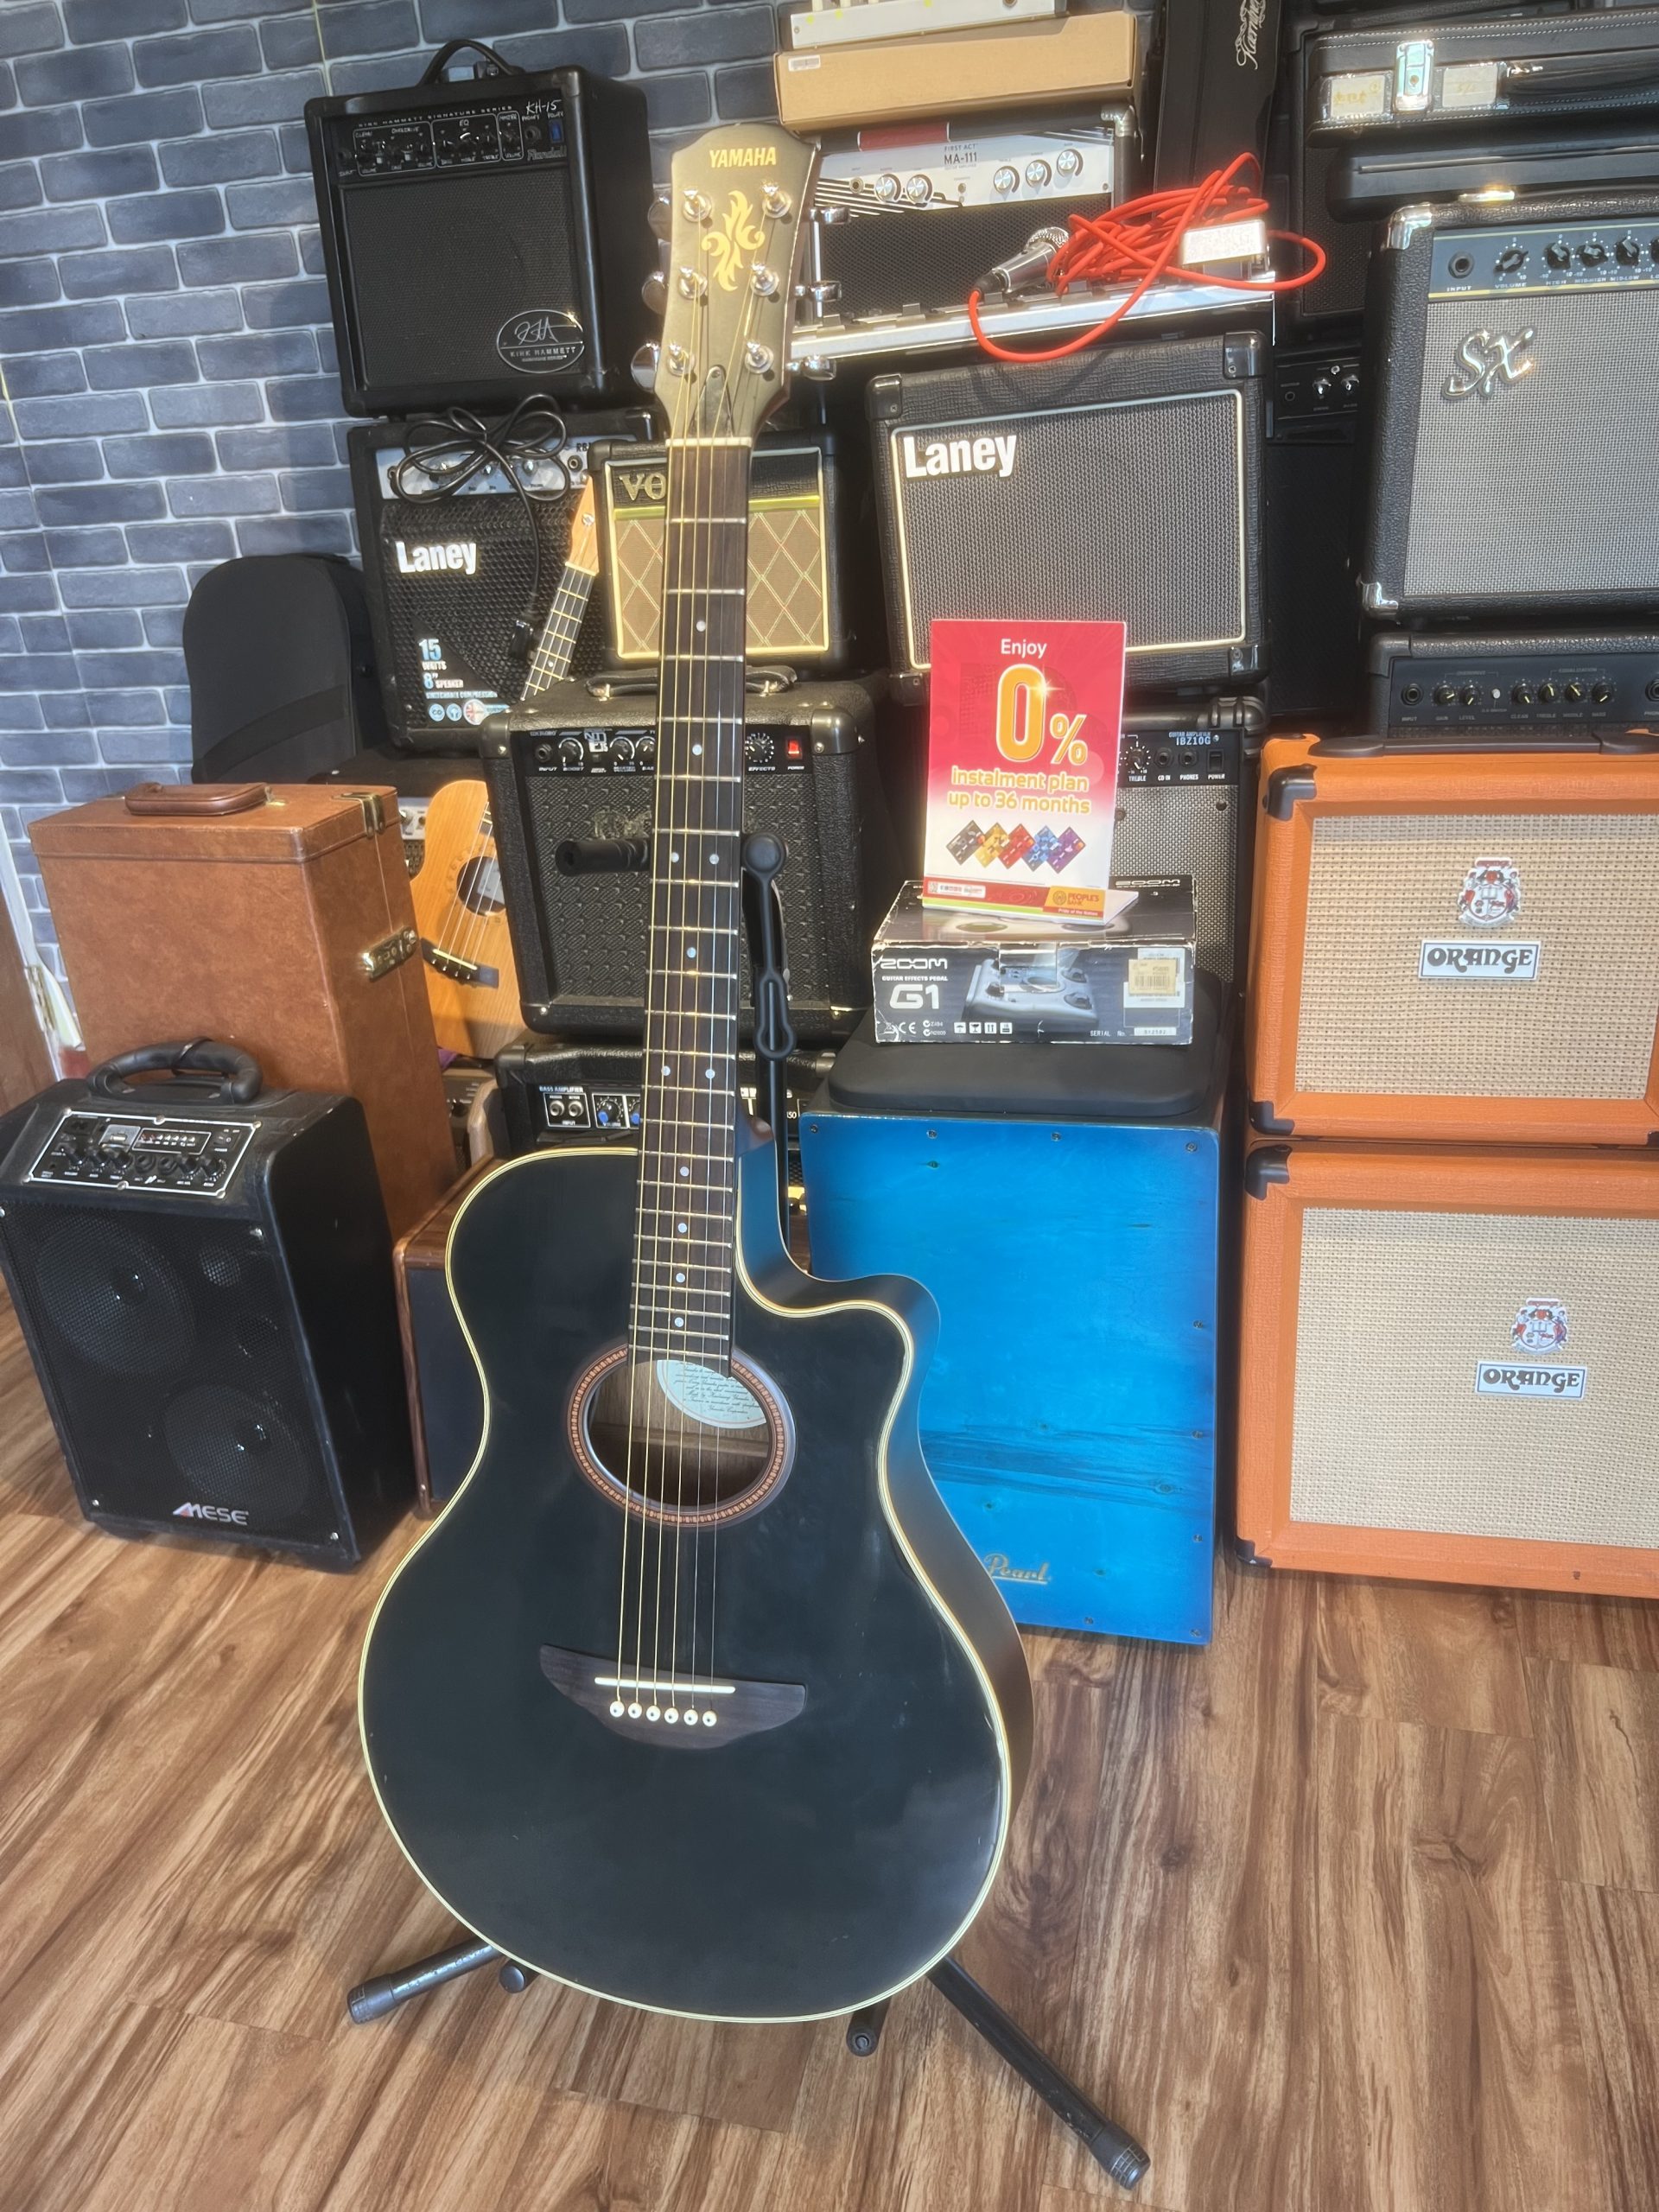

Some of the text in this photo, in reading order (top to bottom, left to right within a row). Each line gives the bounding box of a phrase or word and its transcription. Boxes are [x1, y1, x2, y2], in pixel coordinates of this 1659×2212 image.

[526, 99, 562, 115] KH-15
[709, 146, 777, 168] YAMAHA
[944, 151, 978, 165] MA-111
[534, 346, 576, 356] HAMMETT
[1441, 327, 1535, 399] SX
[903, 435, 1017, 478] Laney
[619, 473, 667, 501] VO
[395, 541, 477, 575] Laney
[419, 639, 442, 661] 15
[1001, 639, 1047, 658] Enjoy
[422, 660, 448, 671] WATTS
[996, 664, 1089, 766] 0%
[1176, 736, 1211, 746] IBZ10G
[951, 766, 1090, 794] instalment plan
[948, 790, 1092, 815] up to 36 months
[880, 957, 948, 969] ZOOM
[1427, 947, 1533, 974] ORANGE
[889, 983, 940, 1009] G1
[1483, 1368, 1580, 1394] ORANGE
[172, 1502, 250, 1526] MESE
[984, 1552, 1051, 1581] Pearl
